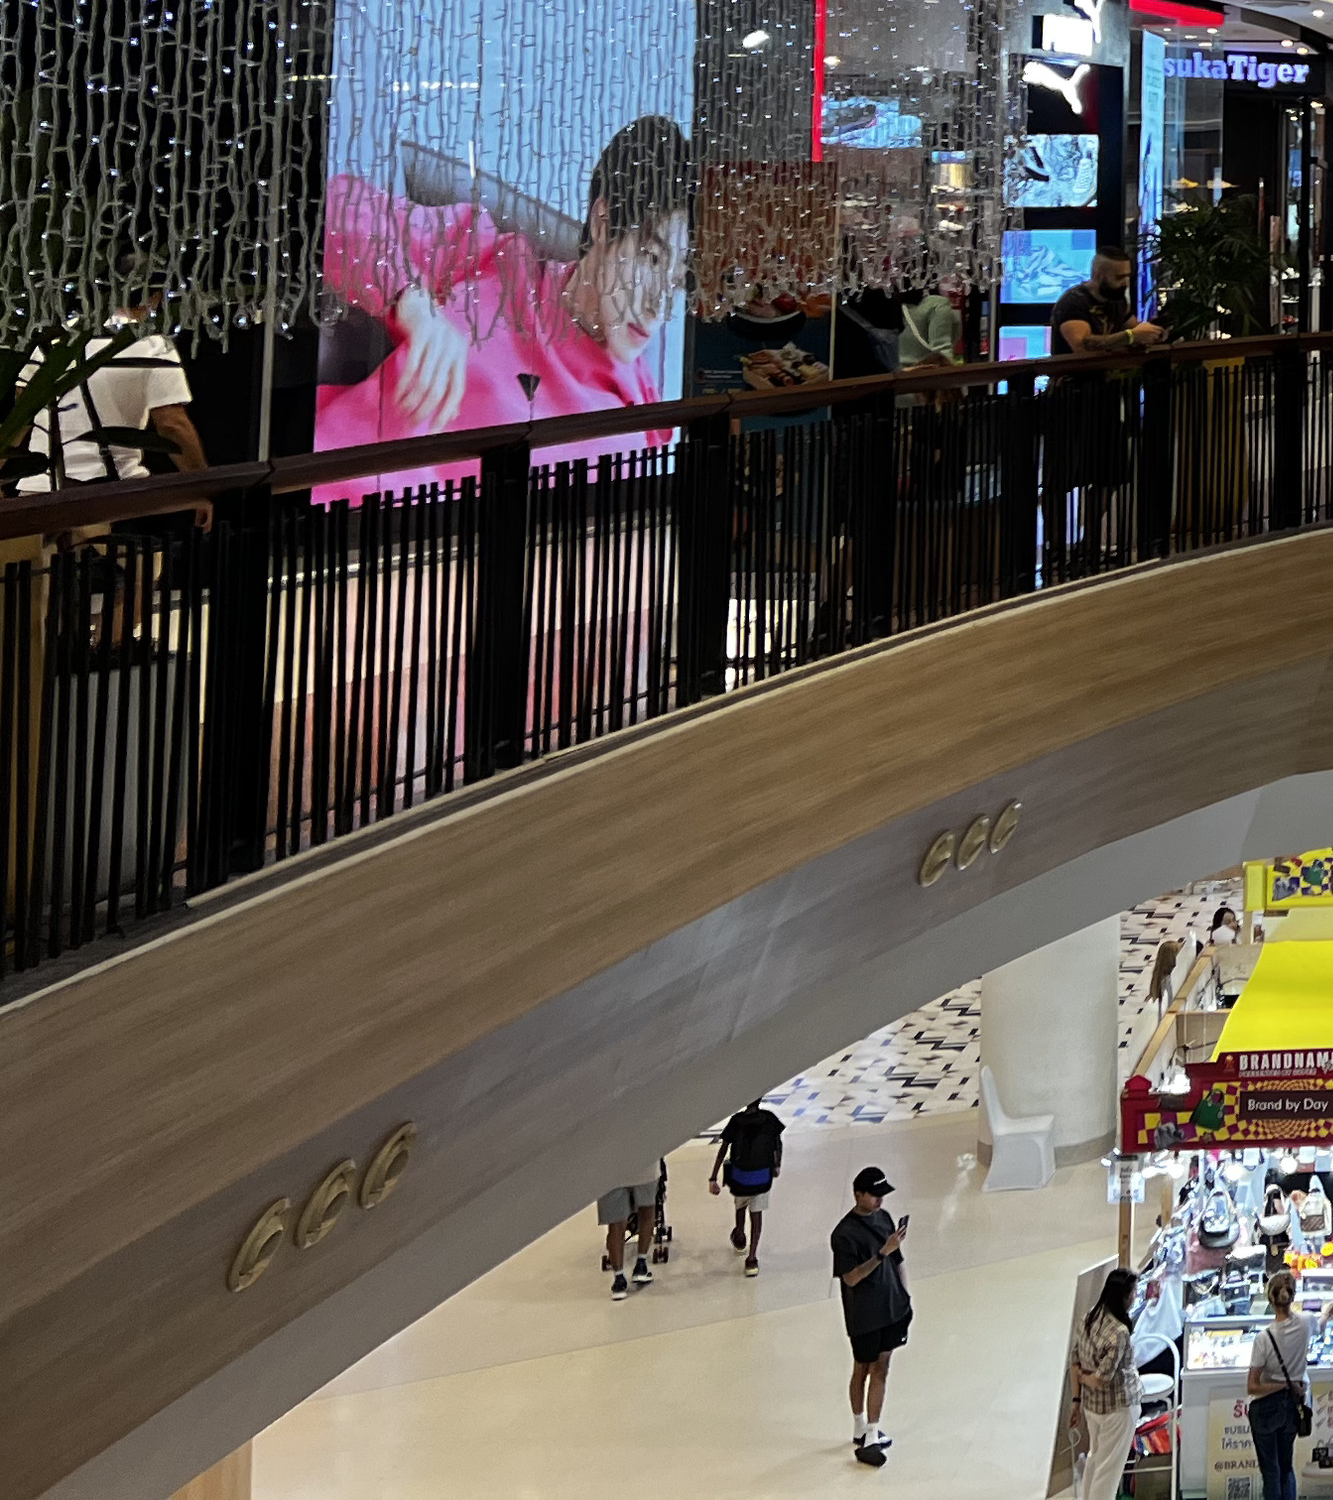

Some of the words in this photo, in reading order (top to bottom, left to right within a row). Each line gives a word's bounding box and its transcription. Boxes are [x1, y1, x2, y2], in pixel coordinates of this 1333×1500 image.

[1247, 1098, 1282, 1111] Brand
[1285, 1097, 1301, 1113] by
[1303, 1097, 1329, 1113] Day
